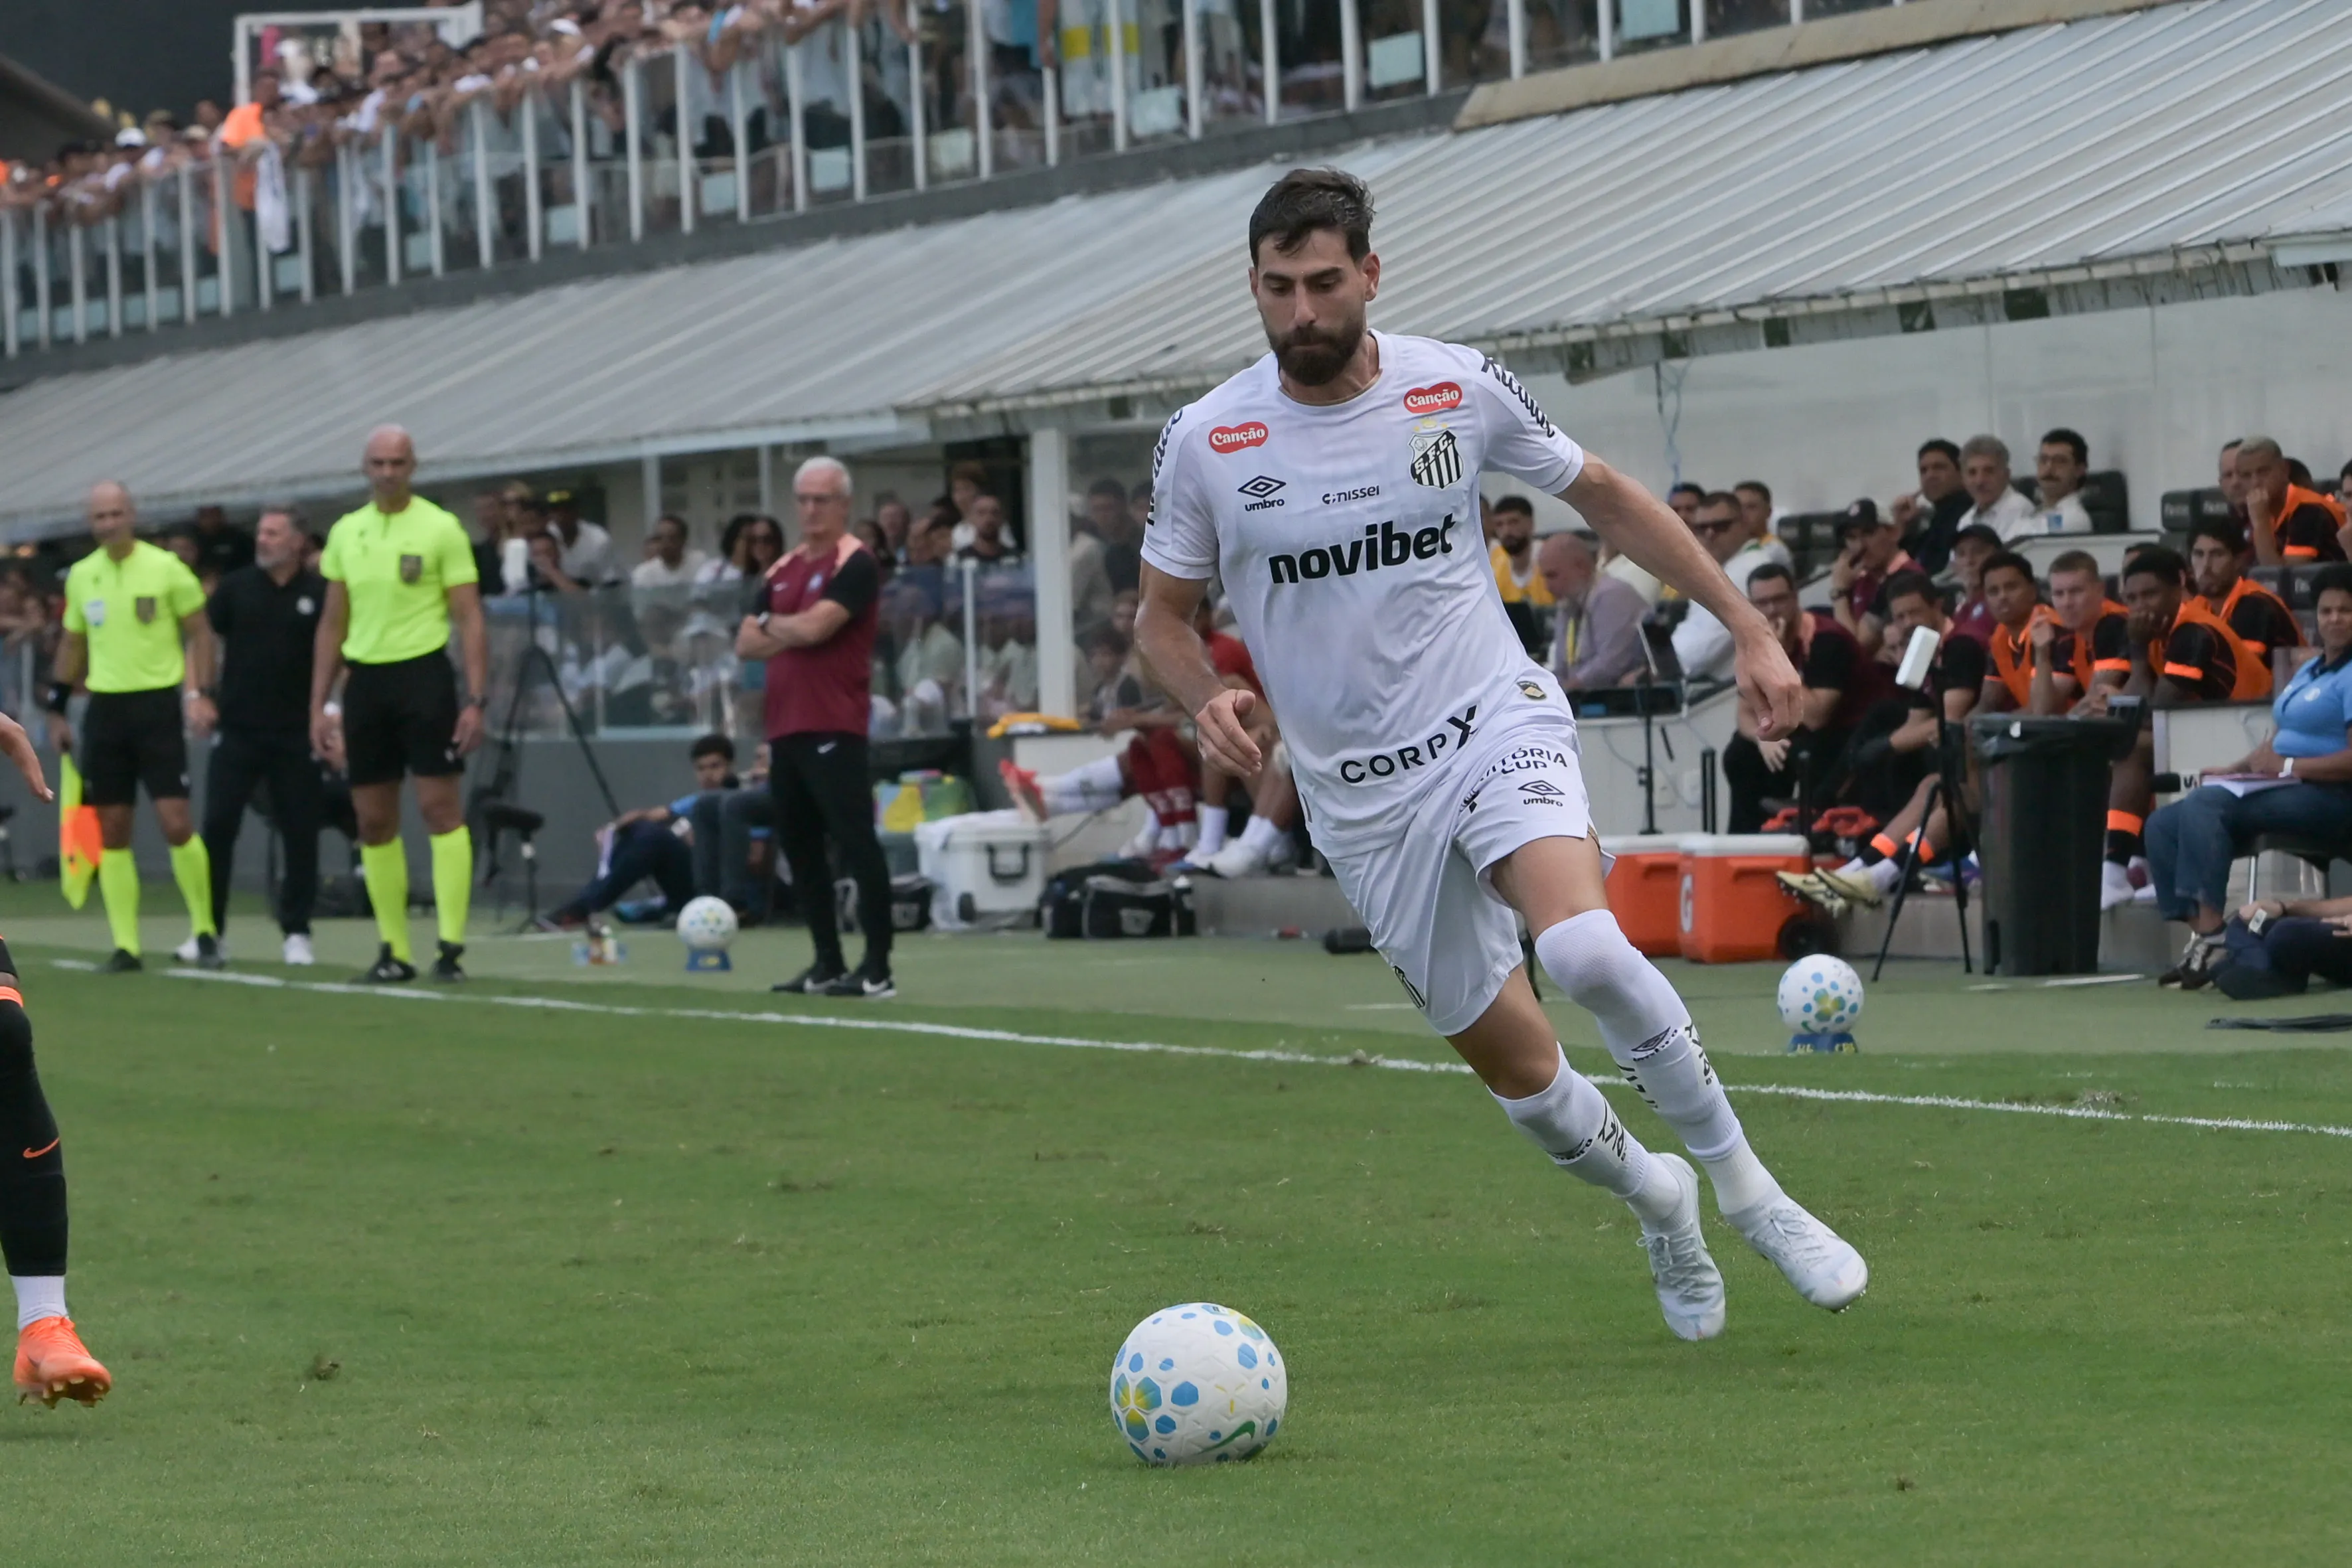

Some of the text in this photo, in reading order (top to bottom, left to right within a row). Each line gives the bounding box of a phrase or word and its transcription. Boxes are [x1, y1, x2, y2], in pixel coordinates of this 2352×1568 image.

[1406, 388, 1459, 408] Canção
[1212, 427, 1265, 445] Canção
[1245, 498, 1285, 512] umbro
[1268, 512, 1456, 584] novibet
[1340, 704, 1479, 784] CORPX
[1523, 795, 1564, 808] umbro
